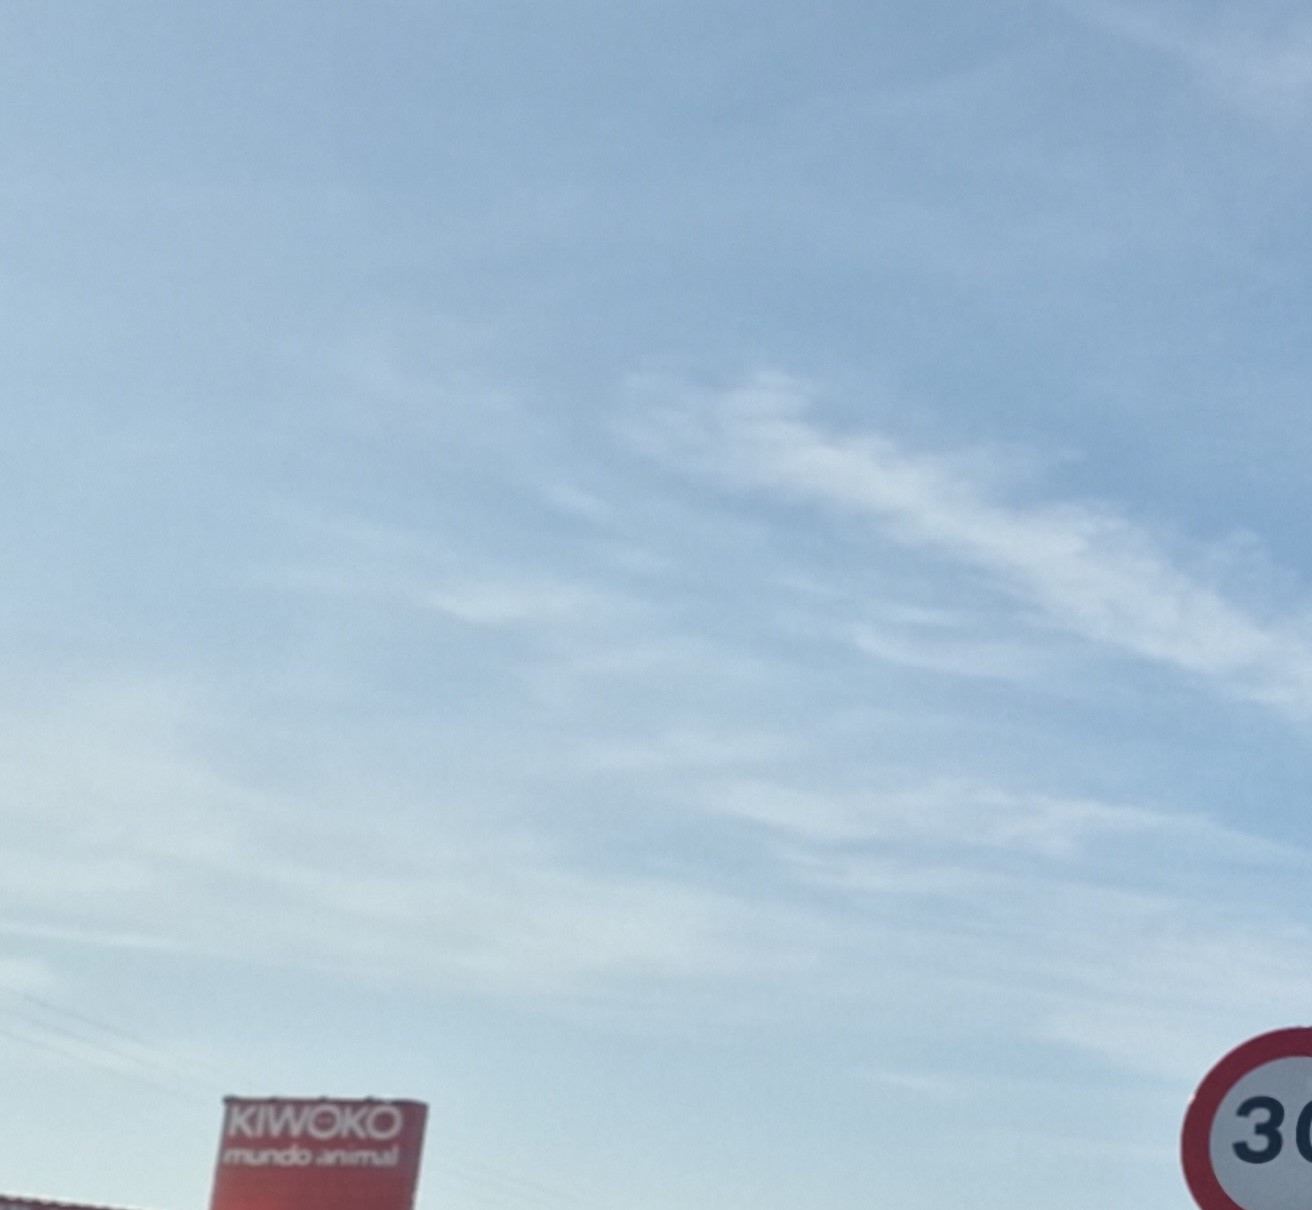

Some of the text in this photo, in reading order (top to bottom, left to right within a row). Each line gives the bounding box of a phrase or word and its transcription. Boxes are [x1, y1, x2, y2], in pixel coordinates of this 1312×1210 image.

[229, 1104, 404, 1140] KIWOKO
[223, 1145, 399, 1167] mundo animal
